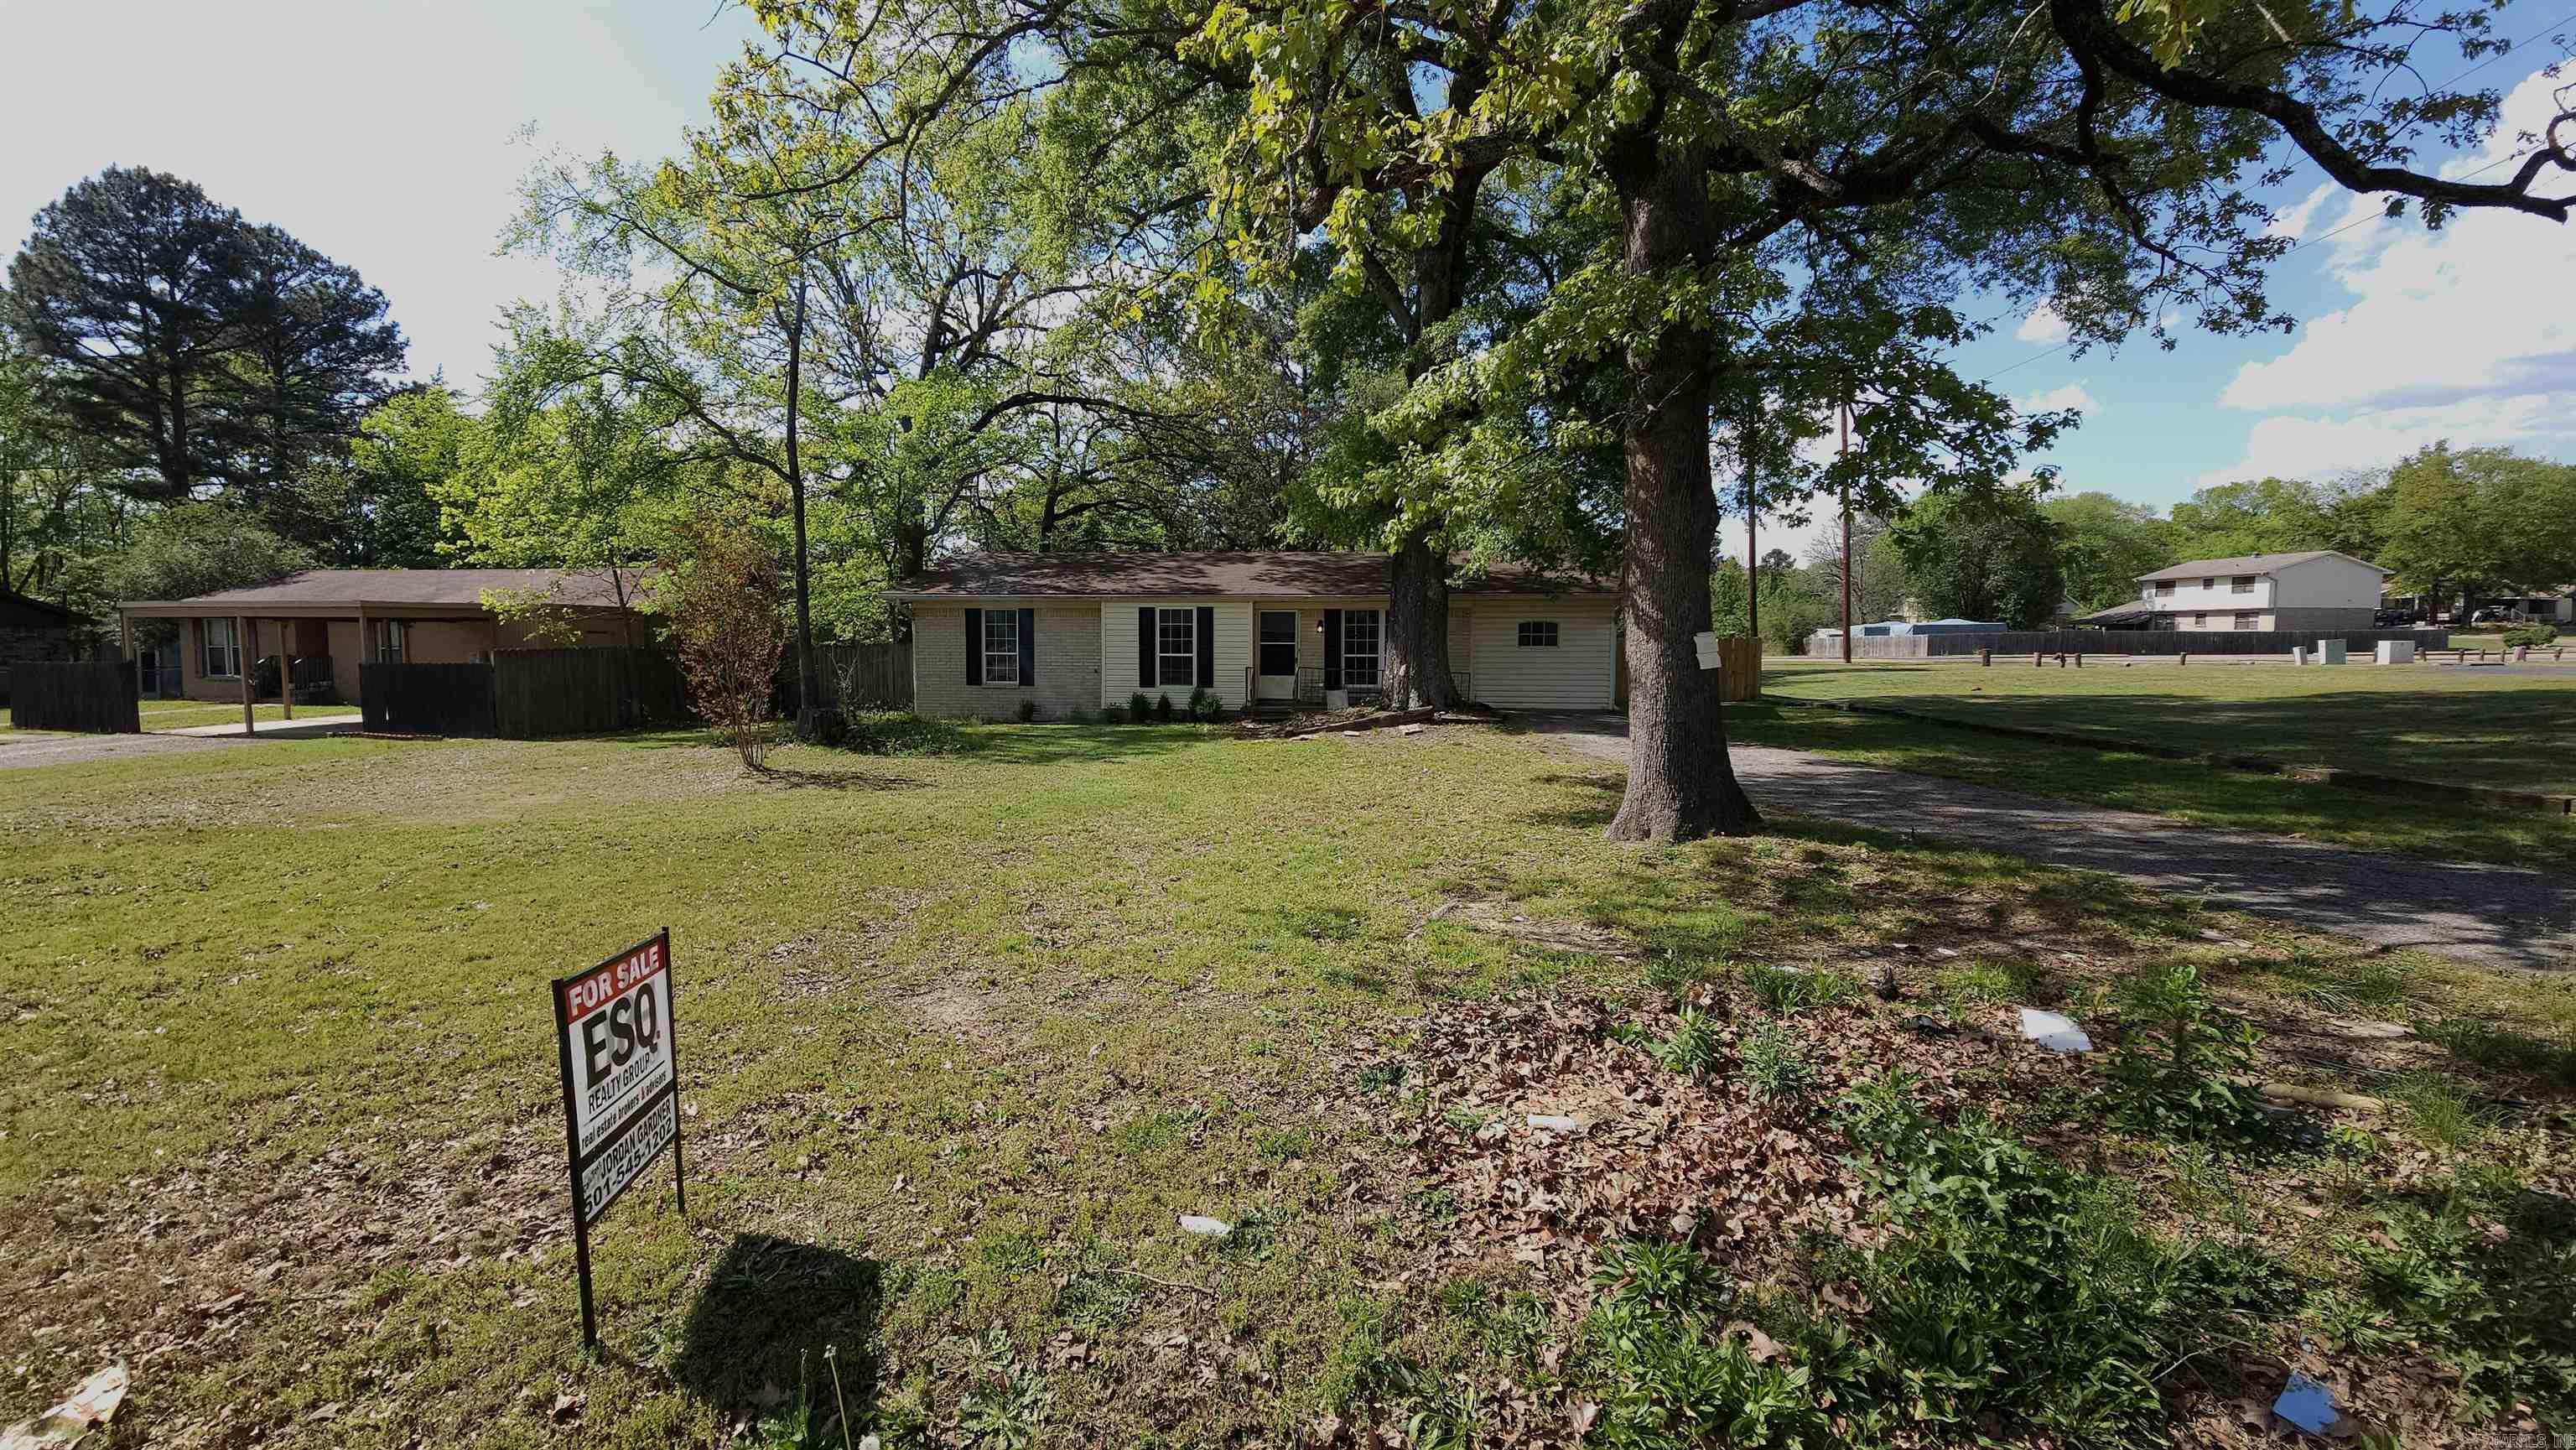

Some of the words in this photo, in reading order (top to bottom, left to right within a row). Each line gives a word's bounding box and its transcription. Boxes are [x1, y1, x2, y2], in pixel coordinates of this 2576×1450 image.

[569, 971, 614, 1016] FOR
[617, 945, 659, 990] SALE
[589, 1073, 621, 1115] REALTY
[623, 1052, 650, 1089] GROUP
[581, 1126, 595, 1150] real
[596, 1110, 617, 1137] estate
[618, 1094, 639, 1120] brokers
[602, 1131, 636, 1179] JORDAN
[637, 1099, 671, 1144] GARDNER
[584, 1117, 673, 1216] 501-545-1202
